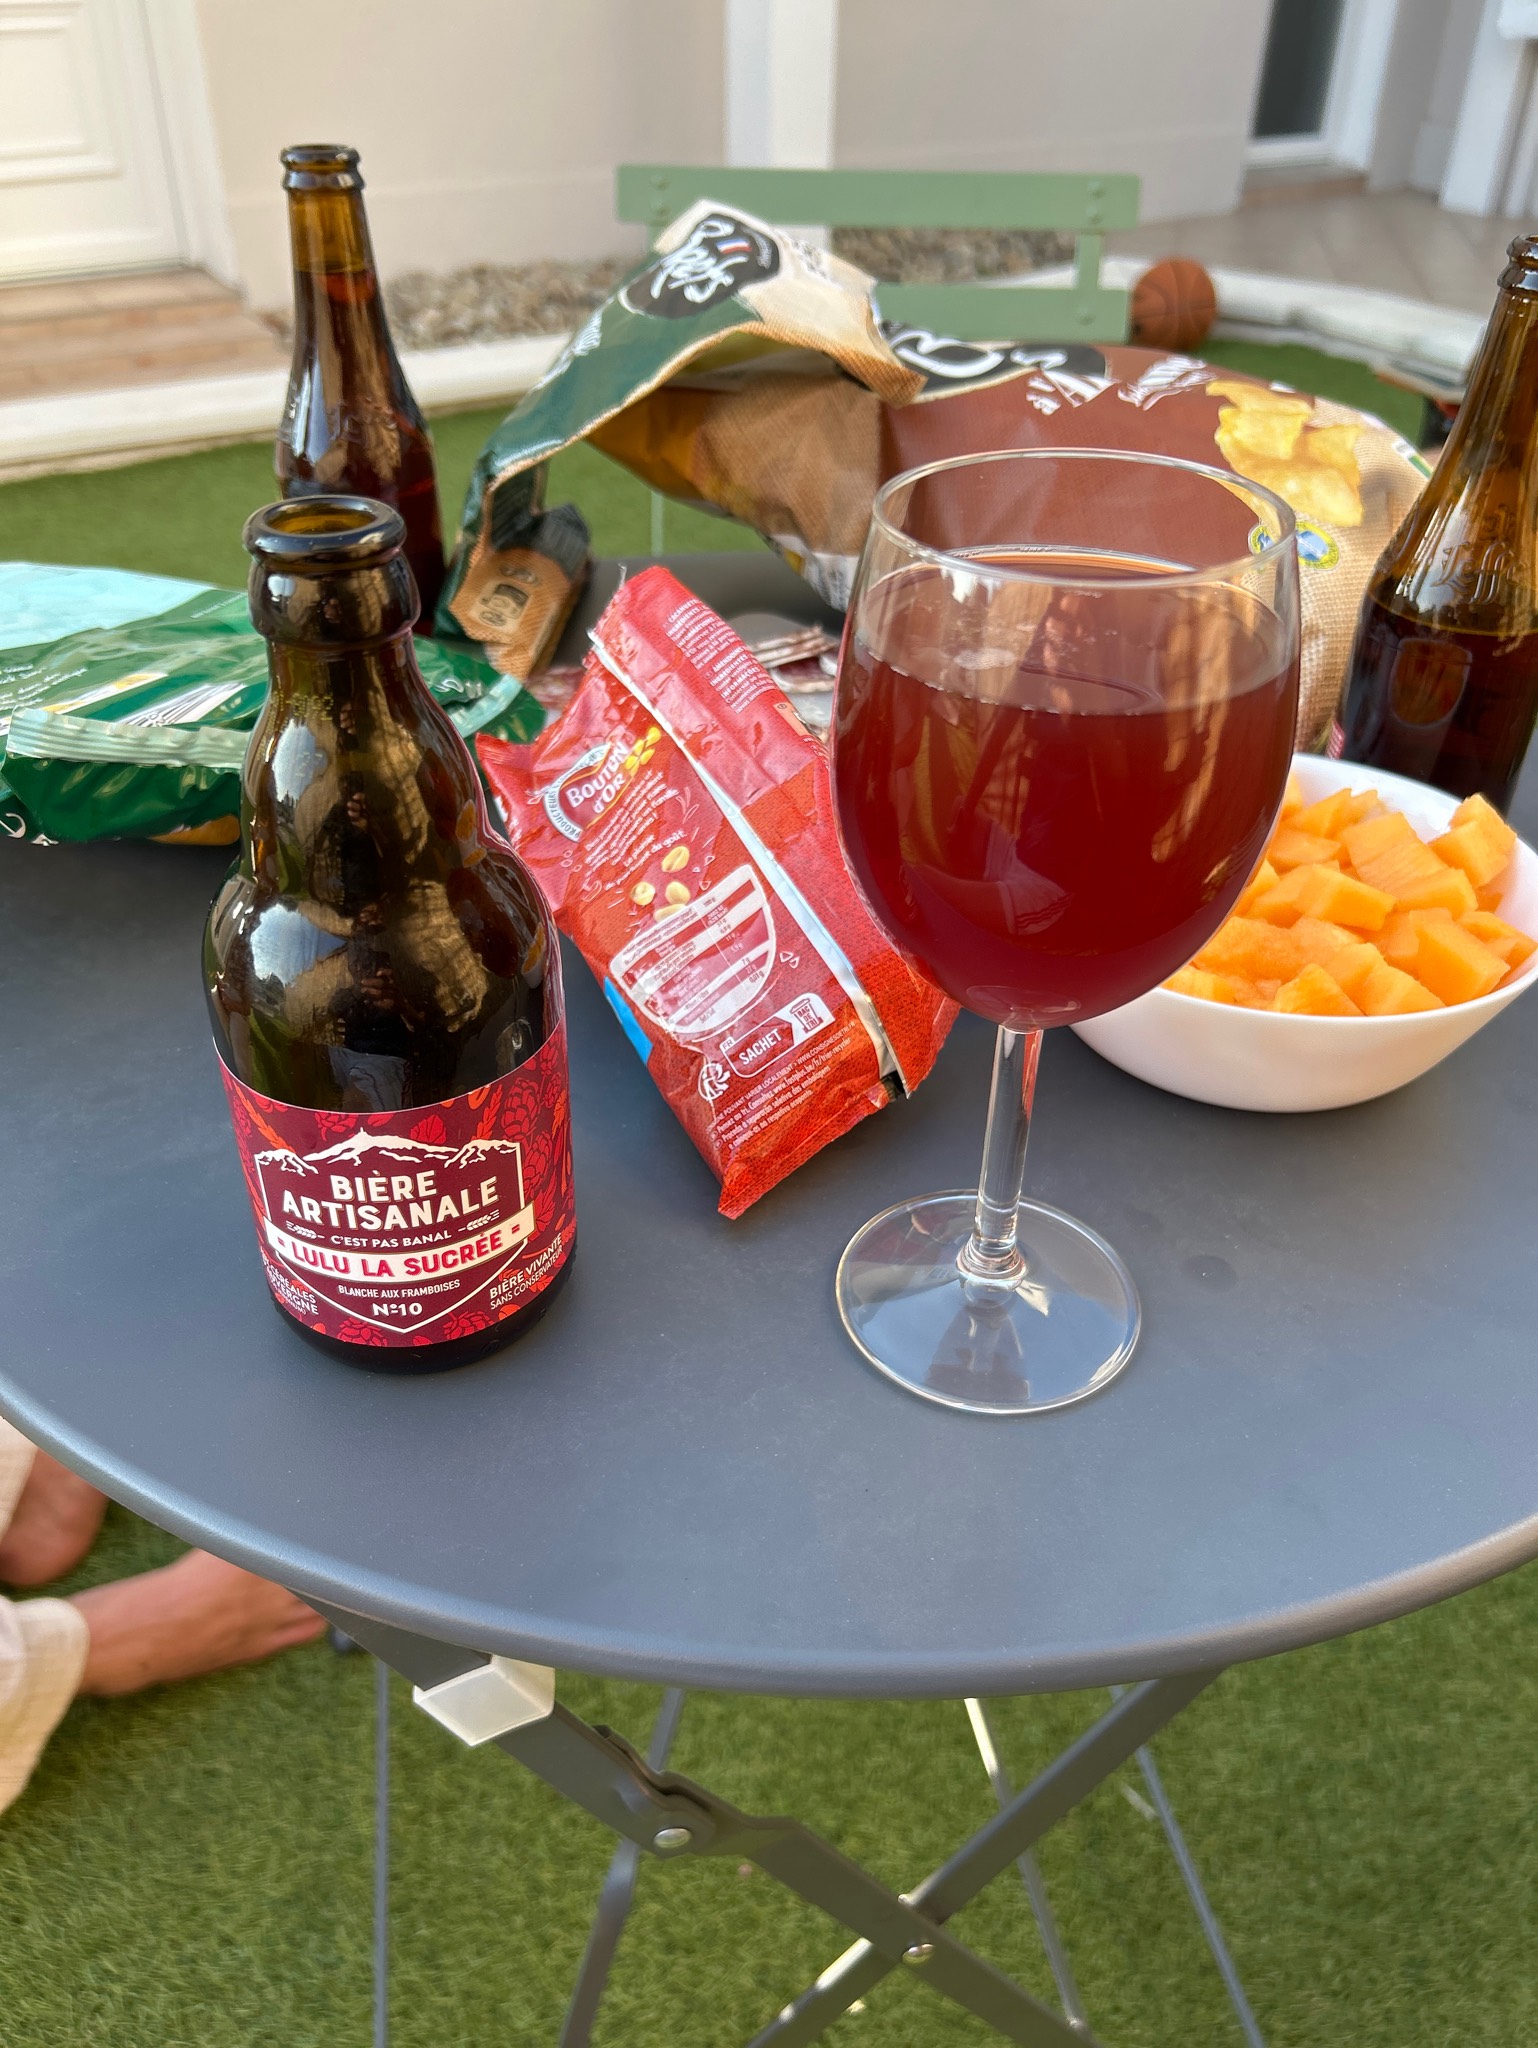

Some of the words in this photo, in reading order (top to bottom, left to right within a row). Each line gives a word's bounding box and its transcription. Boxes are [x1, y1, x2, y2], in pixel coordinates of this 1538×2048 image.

[797, 1005, 810, 1017] BAC
[803, 1013, 812, 1022] DE
[806, 1017, 818, 1029] TRI
[738, 1027, 783, 1066] SACHET
[330, 1169, 437, 1202] BIÈRE
[283, 1176, 498, 1230] ARTISANALE
[292, 1241, 350, 1275] LULU
[361, 1258, 395, 1277] LA
[404, 1229, 503, 1275] SUCRÉE
[331, 1235, 368, 1247] C'EST
[372, 1238, 399, 1247] PAS
[403, 1230, 452, 1246] BANAL
[489, 1270, 525, 1299] BIÈRE
[525, 1232, 562, 1275] VIVANTE
[490, 1291, 513, 1310] SANS
[513, 1245, 563, 1296] CONSERVATEUR
[338, 1284, 379, 1298] BLANCHE
[381, 1290, 400, 1298] AUX
[402, 1279, 460, 1298] FRAMBOISES
